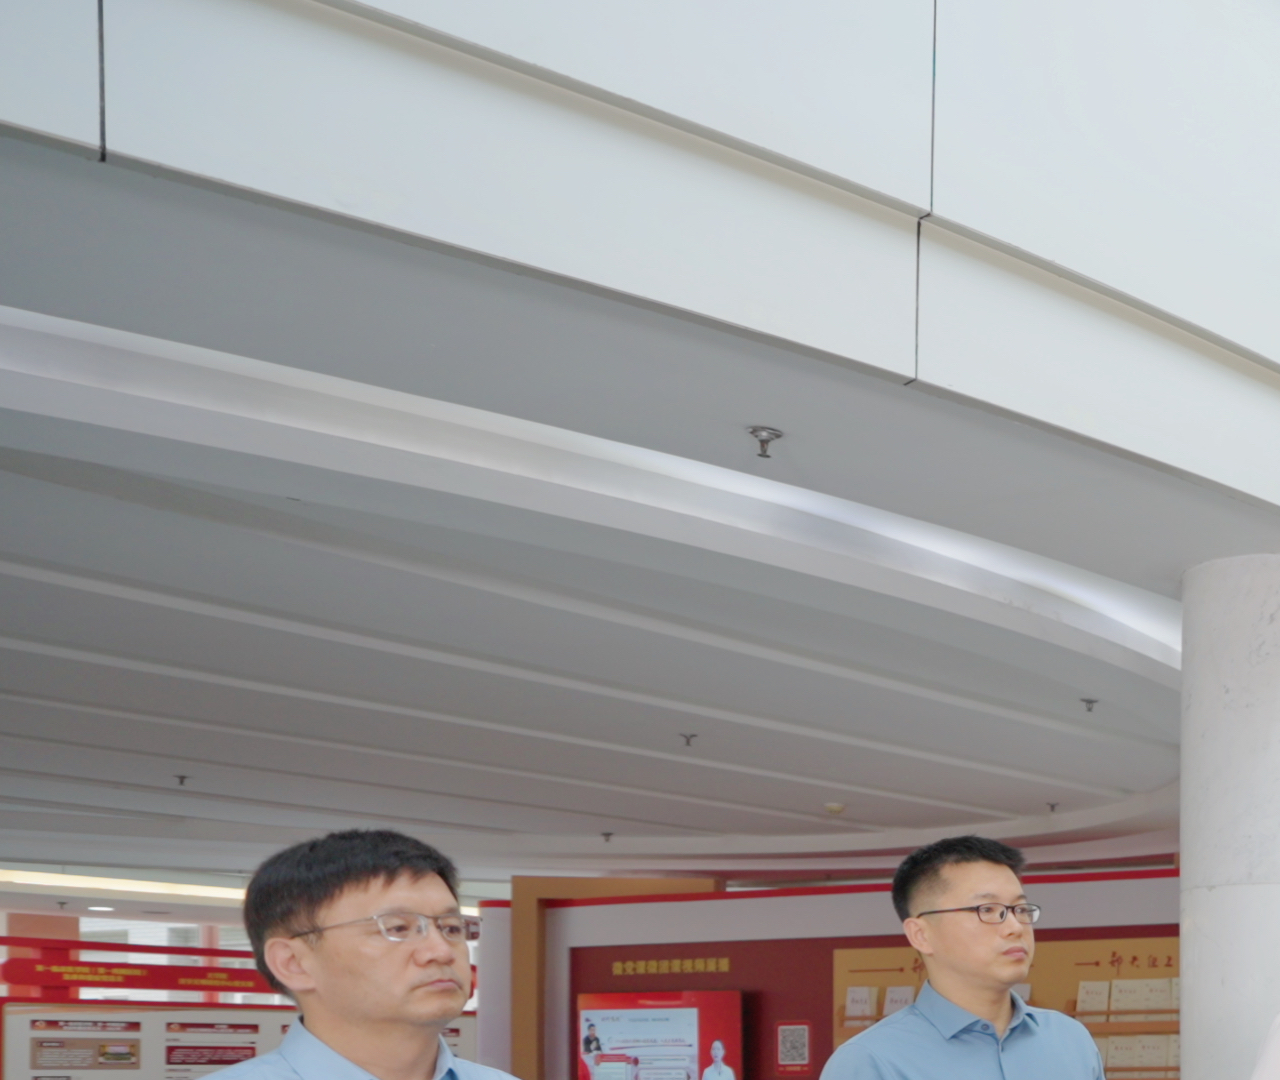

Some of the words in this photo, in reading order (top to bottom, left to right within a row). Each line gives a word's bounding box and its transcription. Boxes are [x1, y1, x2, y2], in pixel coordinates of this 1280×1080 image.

[612, 957, 730, 976] 微党课微团课视频展播
